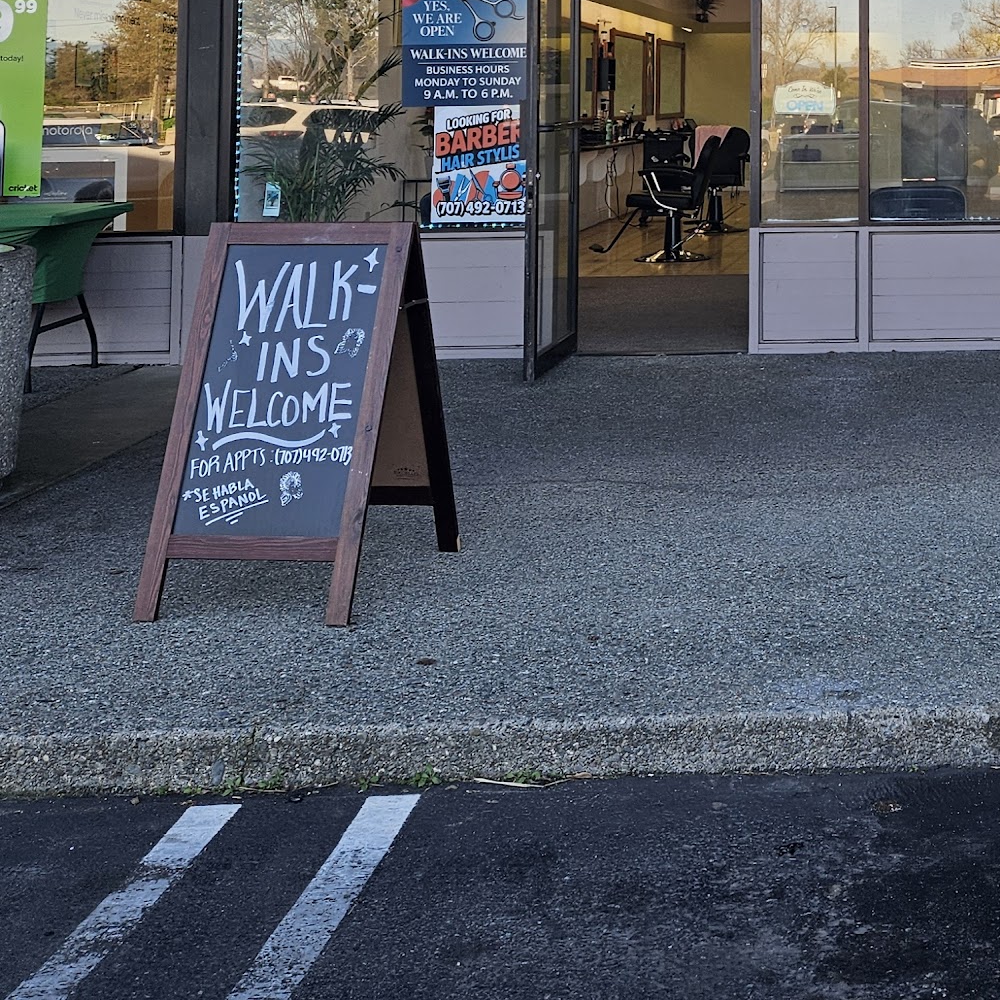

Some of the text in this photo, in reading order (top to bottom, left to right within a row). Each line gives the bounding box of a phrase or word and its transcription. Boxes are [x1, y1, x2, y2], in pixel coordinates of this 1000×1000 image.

[423, 1, 450, 12] YES,
[412, 13, 462, 24] WE ARE
[420, 25, 455, 36] OPEN
[410, 47, 527, 60] WALK-INS WELCOME
[426, 65, 510, 75] BUSINESS HOURS
[414, 76, 522, 87] MONDAY TO SUNDAY
[423, 88, 514, 99] 9 A.M. TO 6 P.M.
[786, 100, 824, 111] OPEN
[446, 108, 512, 130] LOOKING FOR
[441, 152, 474, 172] HAIR
[235, 260, 377, 333] WALK-
[256, 335, 331, 382] INS
[204, 379, 352, 434] WELCOME
[190, 455, 220, 479] FOR
[213, 478, 255, 499] HABLA
[199, 488, 267, 520] ESPANOL
